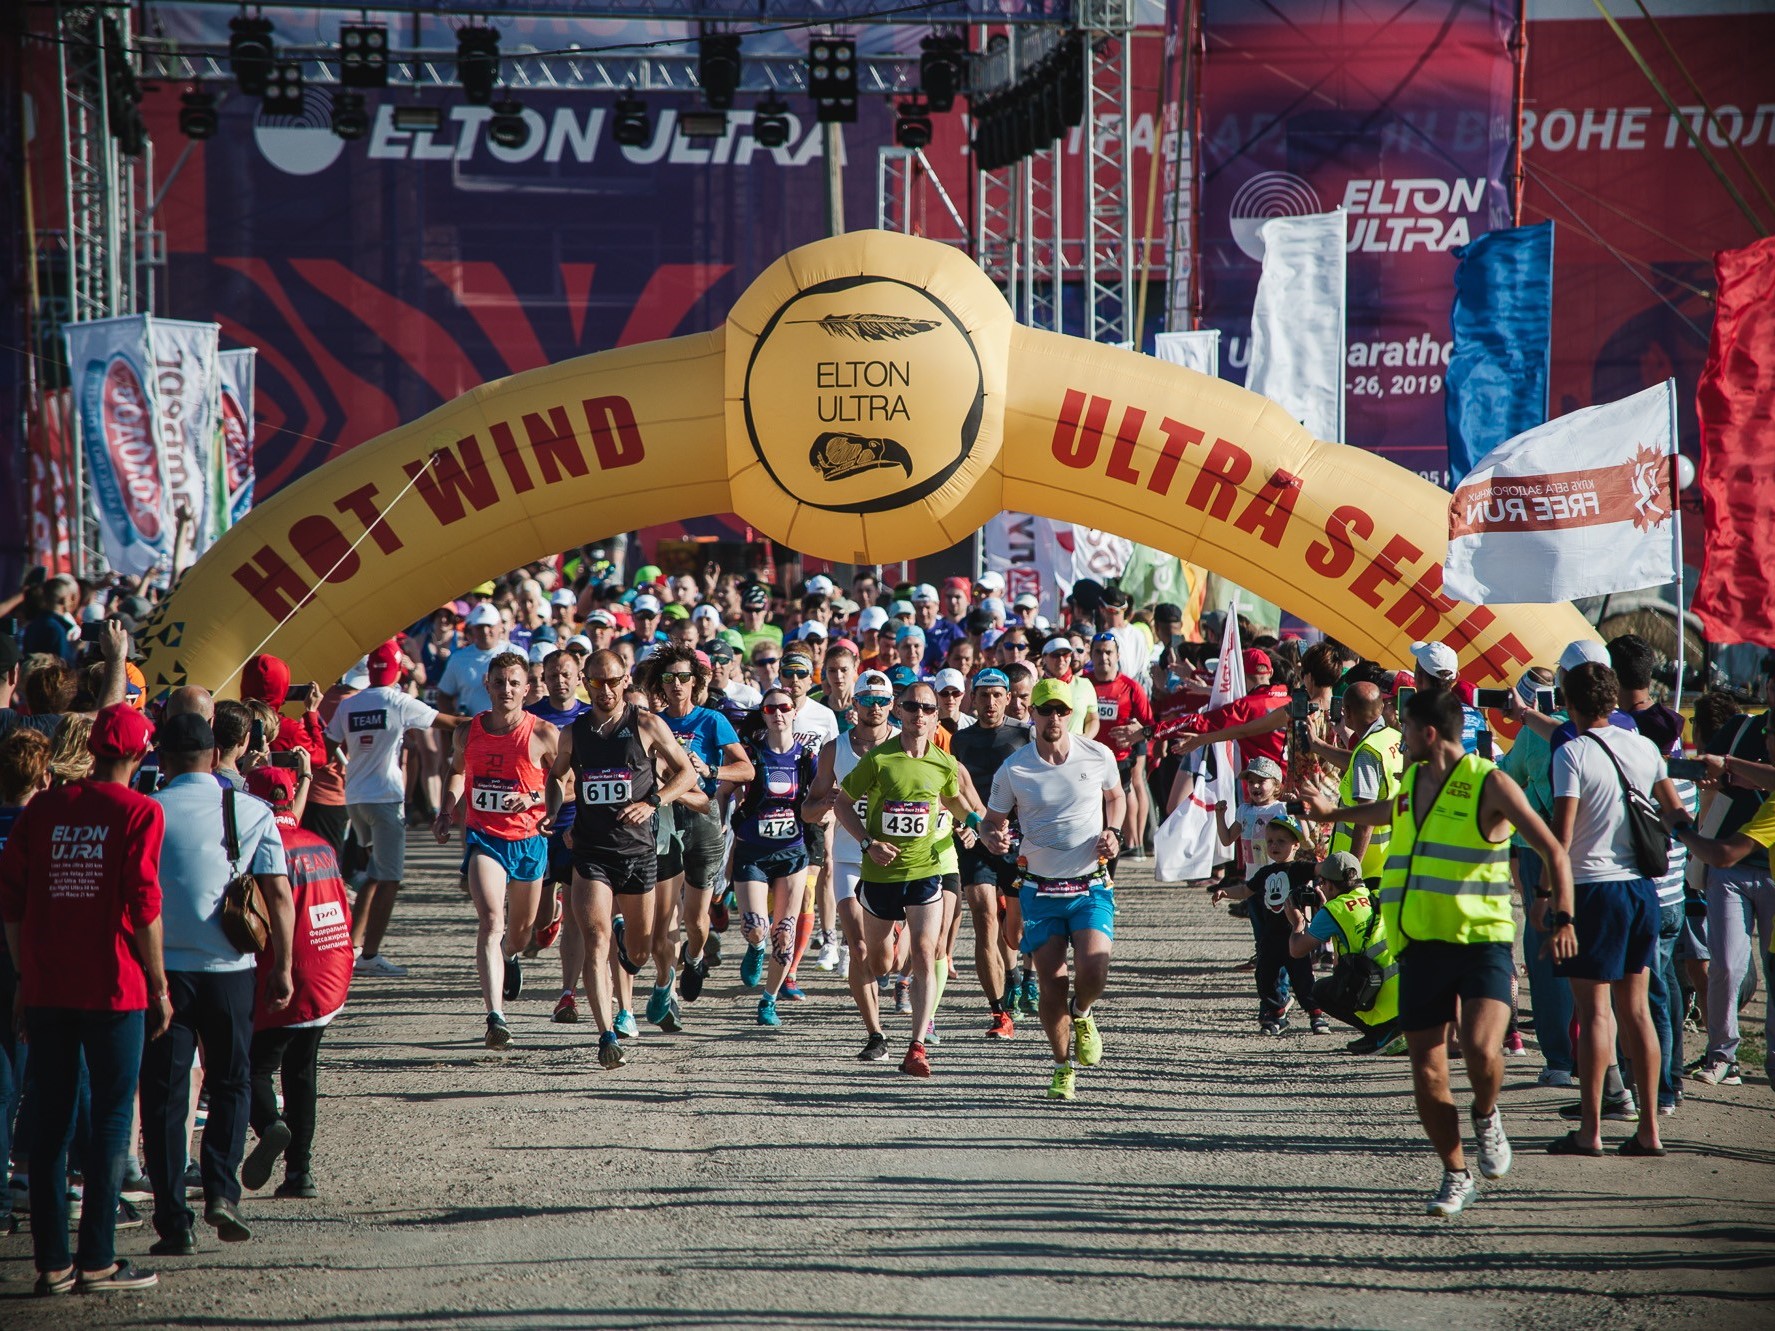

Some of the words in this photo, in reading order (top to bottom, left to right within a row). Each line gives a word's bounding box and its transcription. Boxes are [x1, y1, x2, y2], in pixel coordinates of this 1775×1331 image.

[367, 104, 605, 163] ELTON
[621, 108, 848, 166] ULTRA
[1521, 107, 1652, 152] ЗОНЕ
[1342, 178, 1486, 215] ELTON
[1346, 217, 1470, 252] ULTRA
[1347, 333, 1453, 367] aratho
[816, 361, 910, 388] ELTON
[1346, 375, 1384, 398] -26,
[1390, 375, 1442, 394] 2019
[818, 395, 911, 422] ULTRA
[231, 482, 404, 624] HOT
[402, 395, 645, 526] WIND
[1051, 388, 1304, 548] ULTRA
[1304, 505, 1533, 742] SERIE
[353, 714, 382, 726] TEAM
[1098, 706, 1113, 717] 50
[587, 783, 626, 801] 619
[51, 825, 109, 841] ELTON
[764, 821, 796, 836] 473
[887, 816, 924, 834] 436
[288, 852, 338, 875] TEAM
[309, 924, 347, 937] Федеральна
[310, 931, 349, 945] пассажирска
